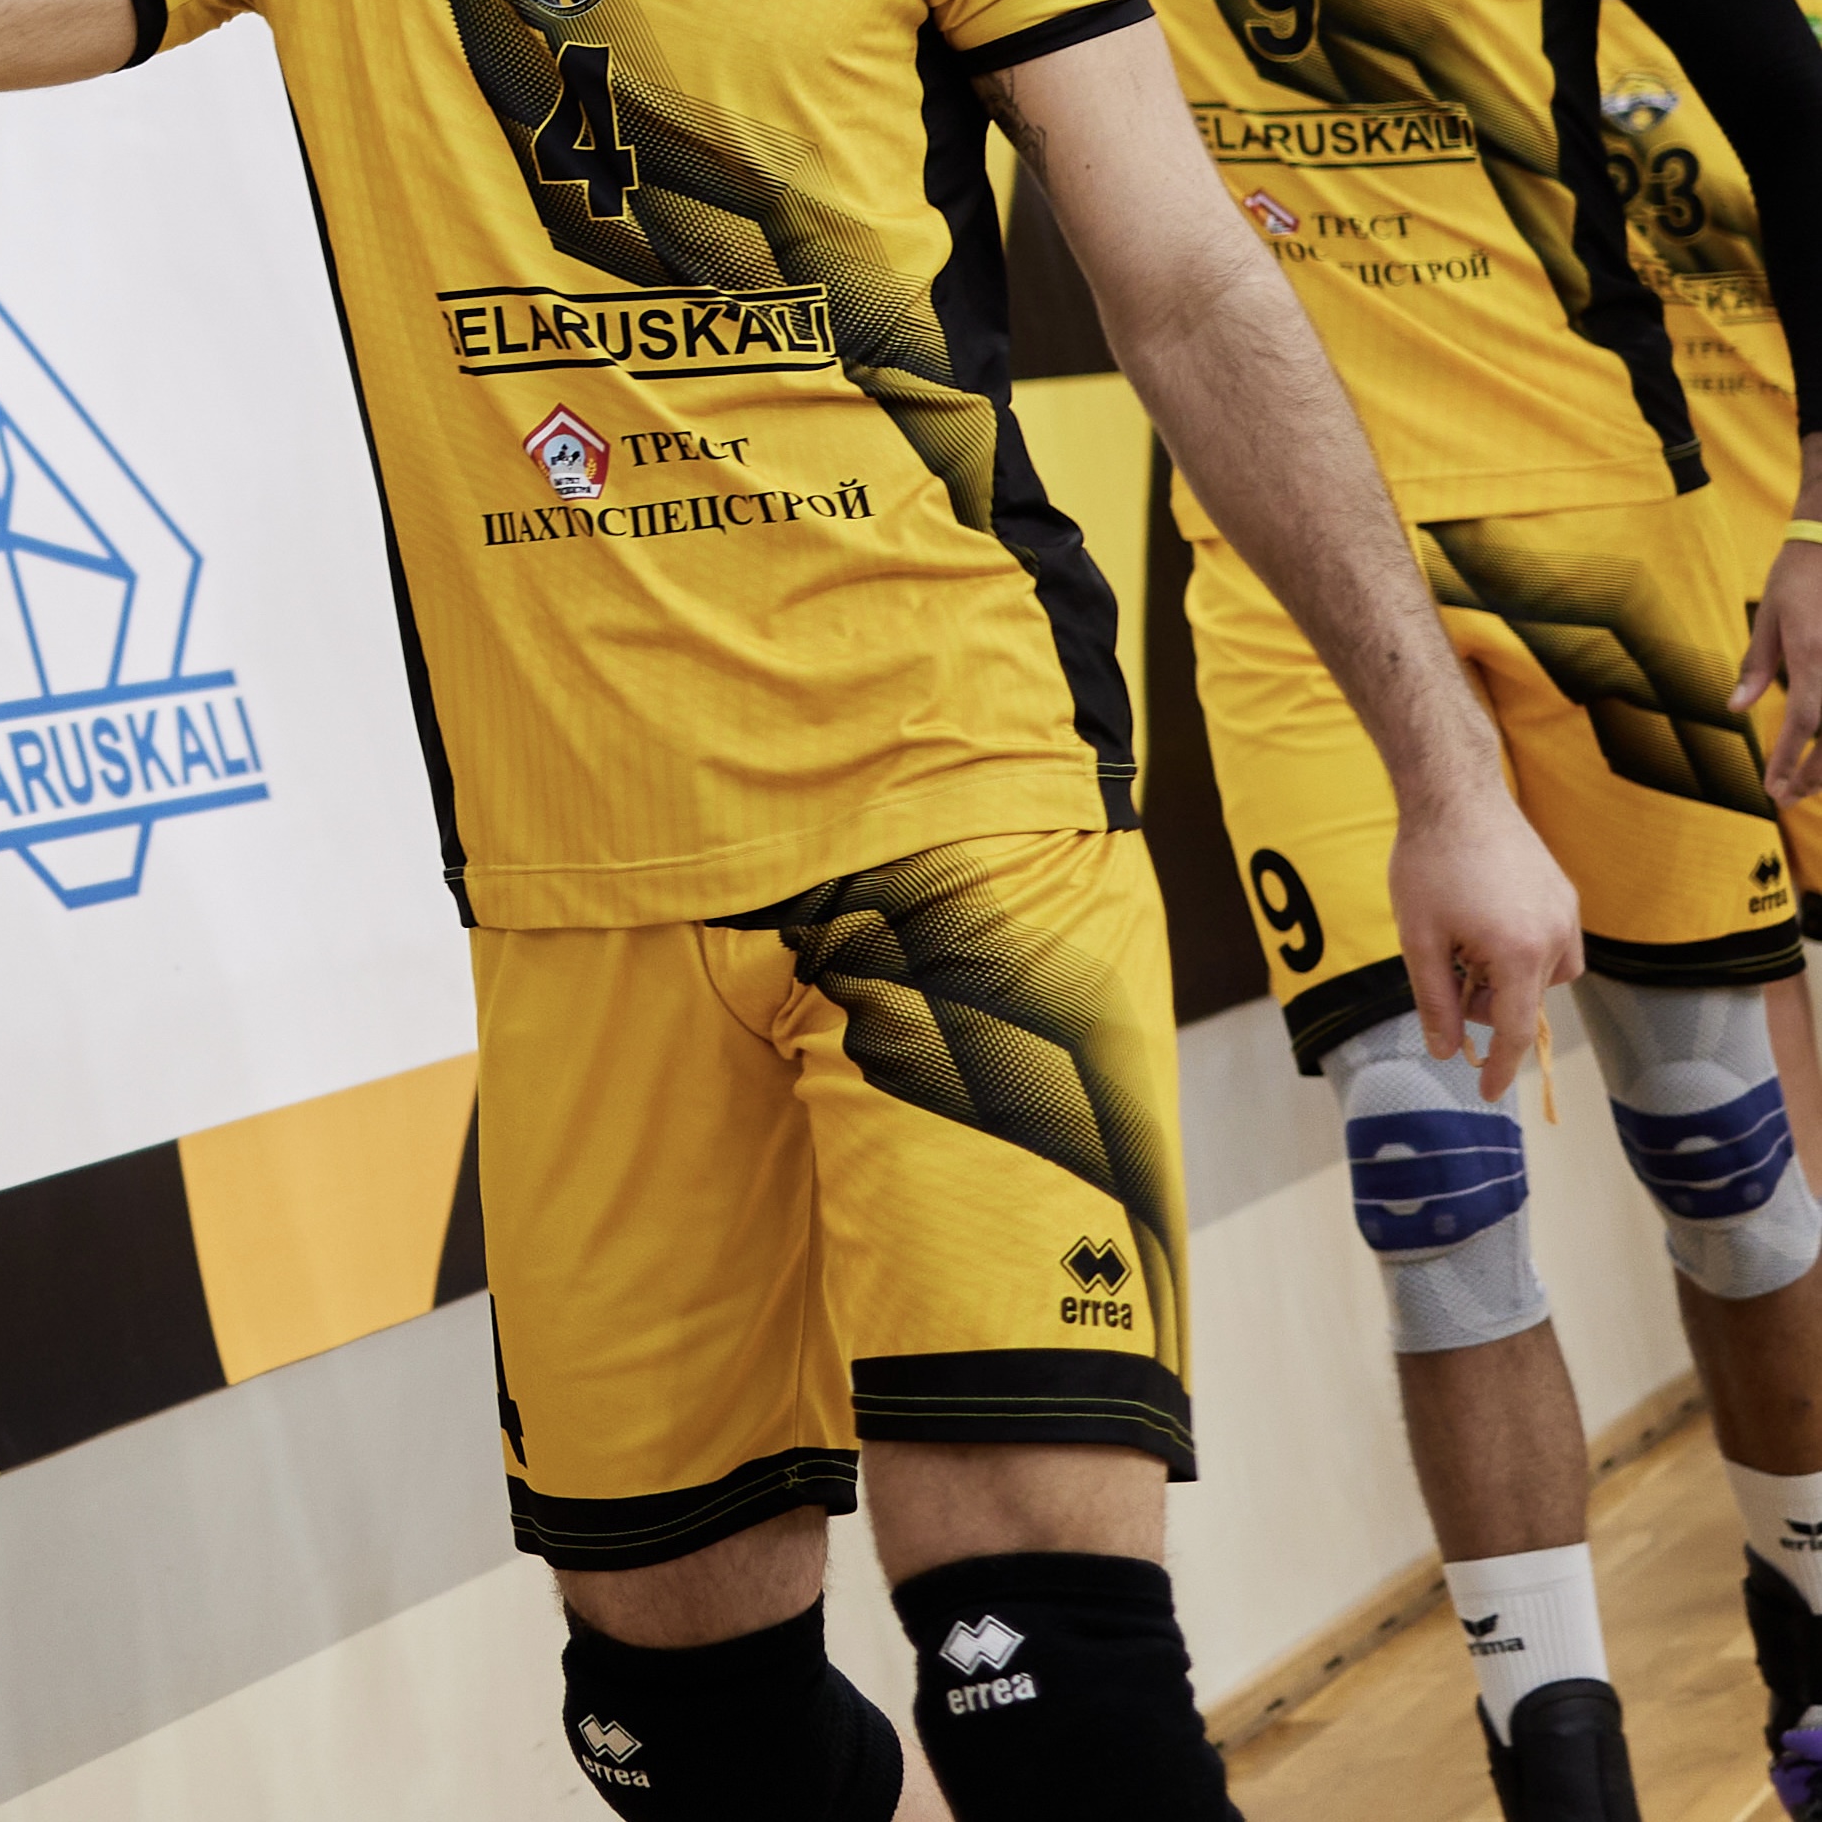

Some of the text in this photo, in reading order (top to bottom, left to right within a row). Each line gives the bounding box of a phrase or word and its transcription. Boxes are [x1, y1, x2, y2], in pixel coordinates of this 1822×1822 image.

[532, 41, 639, 220] 4
[1193, 115, 1474, 157] ELARUSKALI
[442, 300, 837, 361] ELARUSKALI
[620, 431, 750, 468] ТРЕСТ
[1250, 848, 1325, 973] 9
[1060, 1296, 1133, 1331] errea
[1468, 1637, 1525, 1656] rima
